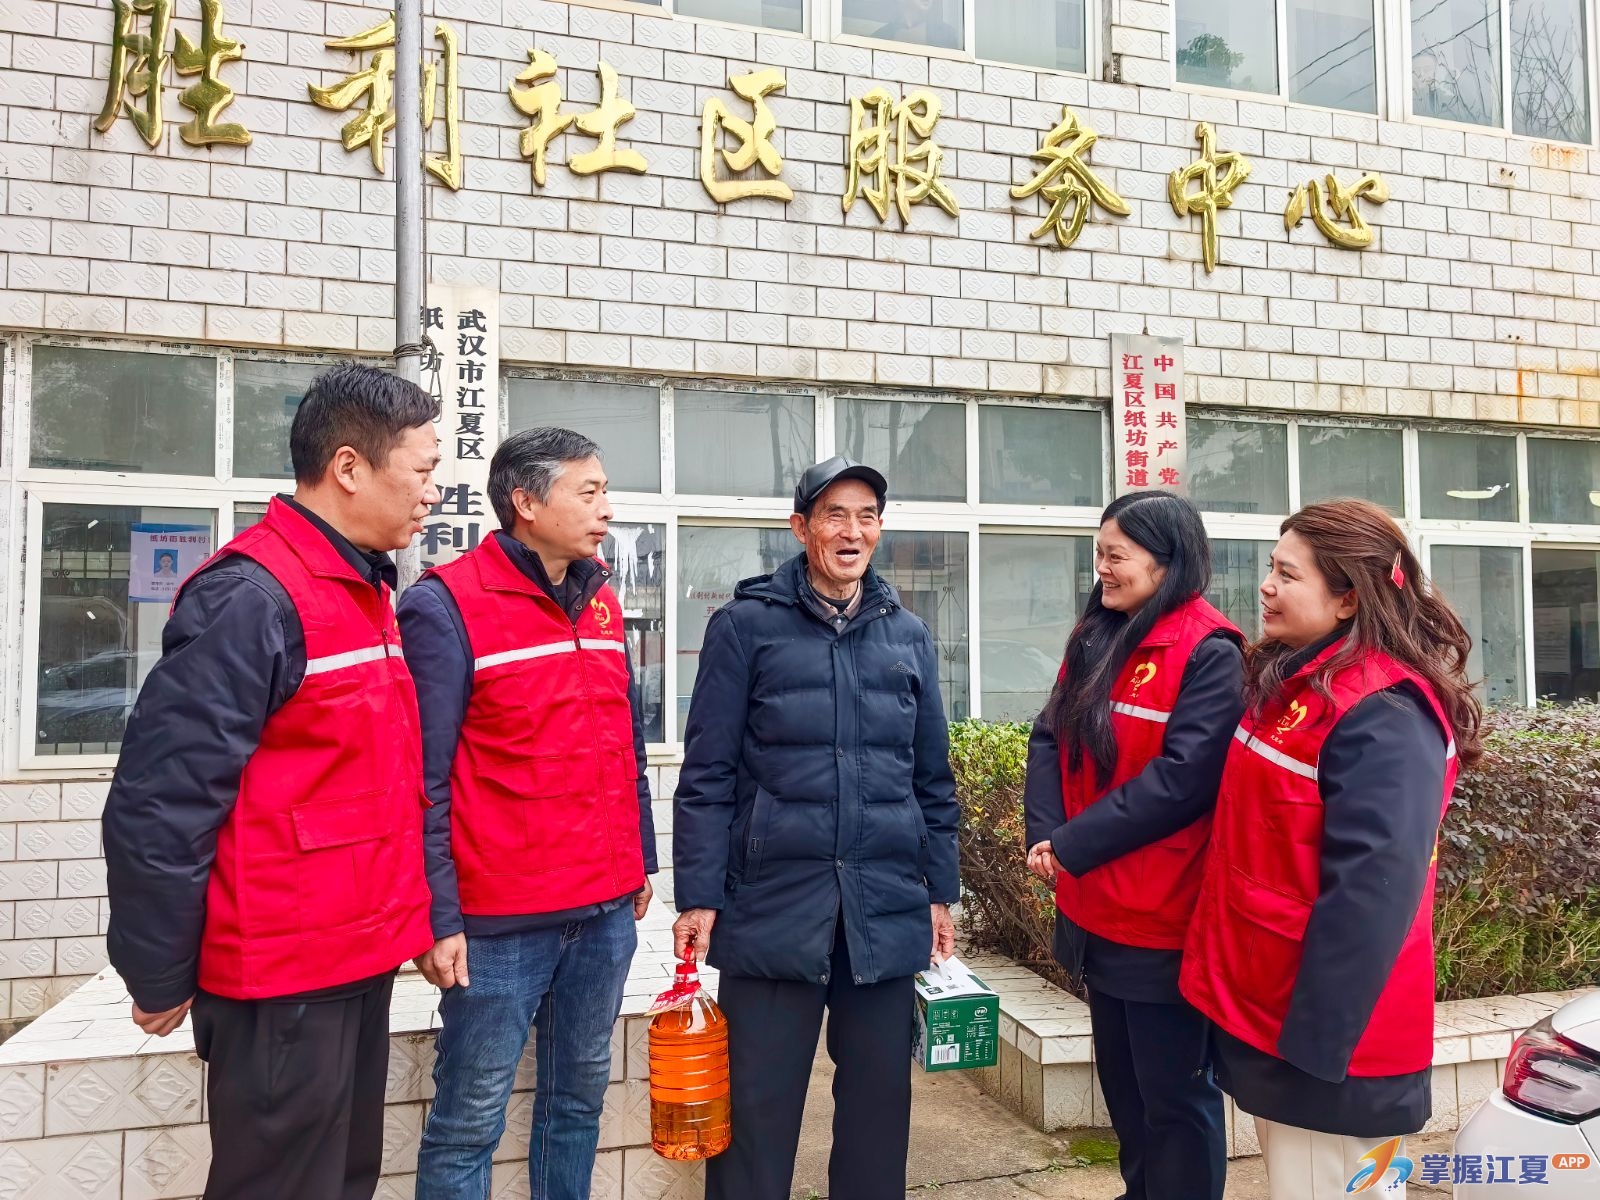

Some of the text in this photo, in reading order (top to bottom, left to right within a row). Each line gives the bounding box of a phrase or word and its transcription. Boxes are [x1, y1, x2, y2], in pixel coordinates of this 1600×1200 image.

[94, 0, 1390, 273] 胜利社区服务中心
[455, 308, 487, 460] 武汉市江夏区
[1122, 354, 1149, 487] 江夏区纸坊街道
[1154, 354, 1180, 485] 中国共产党
[421, 484, 485, 571] 胜利
